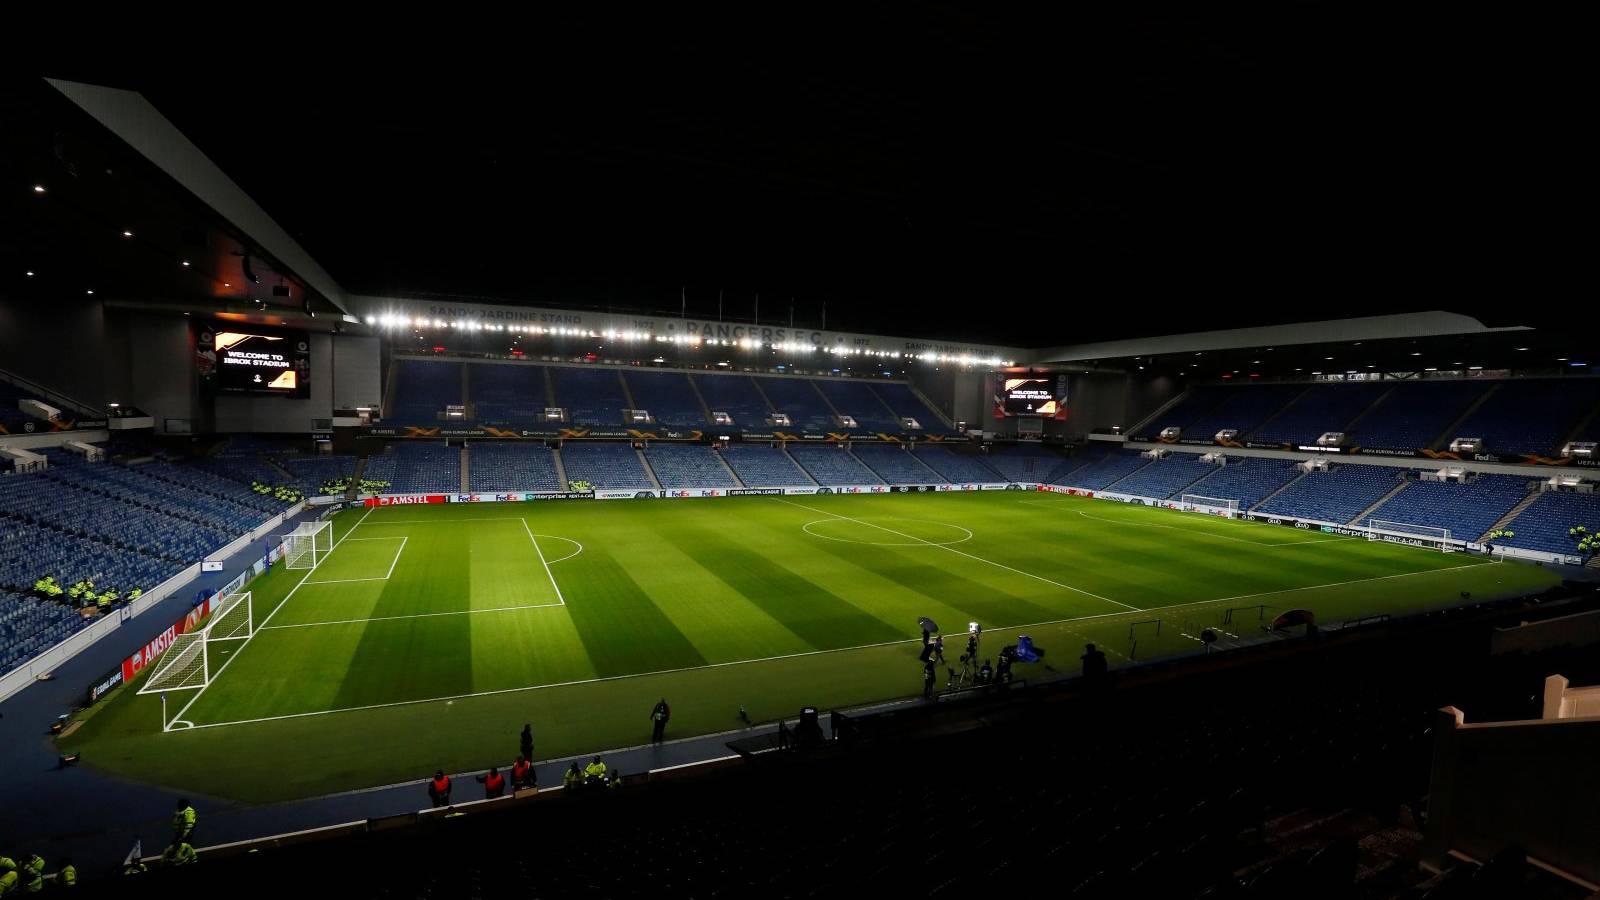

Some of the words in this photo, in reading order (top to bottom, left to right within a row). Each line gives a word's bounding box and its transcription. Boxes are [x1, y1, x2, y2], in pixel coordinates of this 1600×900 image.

[429, 306, 475, 318] SANDY
[479, 308, 537, 322] JARDINE
[541, 313, 582, 325] STAND
[686, 321, 786, 343] RANGERS
[227, 351, 270, 360] WELCOME
[224, 357, 251, 366] IBROX
[253, 359, 290, 368] STADIUM
[671, 490, 689, 498] FedEx
[702, 489, 720, 497] FedEx
[1049, 486, 1069, 495] AMSTEL
[391, 495, 429, 505] AMSTEL
[458, 495, 480, 503] FedEx
[495, 494, 517, 502] FedEx
[1161, 501, 1177, 510] FedEx
[1326, 525, 1377, 539] enterprise
[1384, 535, 1423, 546] RENT-A-CAR
[144, 624, 178, 665] AMSTEL
